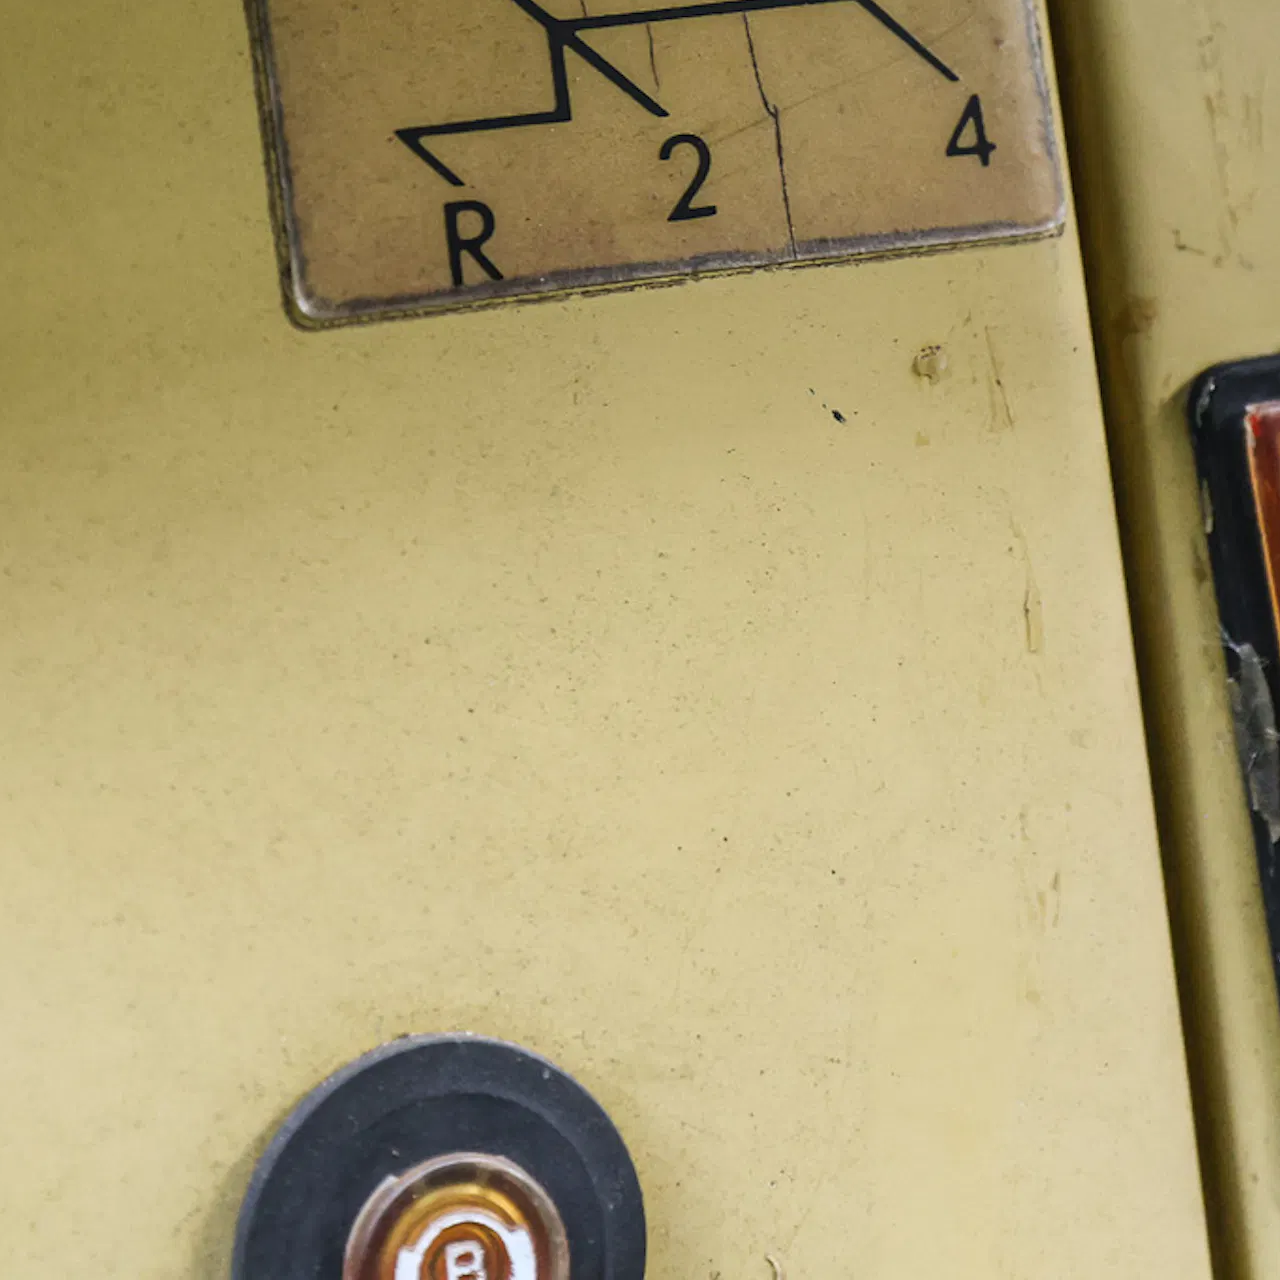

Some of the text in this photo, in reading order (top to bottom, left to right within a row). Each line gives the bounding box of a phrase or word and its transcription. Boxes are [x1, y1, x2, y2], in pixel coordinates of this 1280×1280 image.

[944, 93, 998, 168] 4
[657, 132, 719, 223] 2
[442, 200, 506, 288] R
